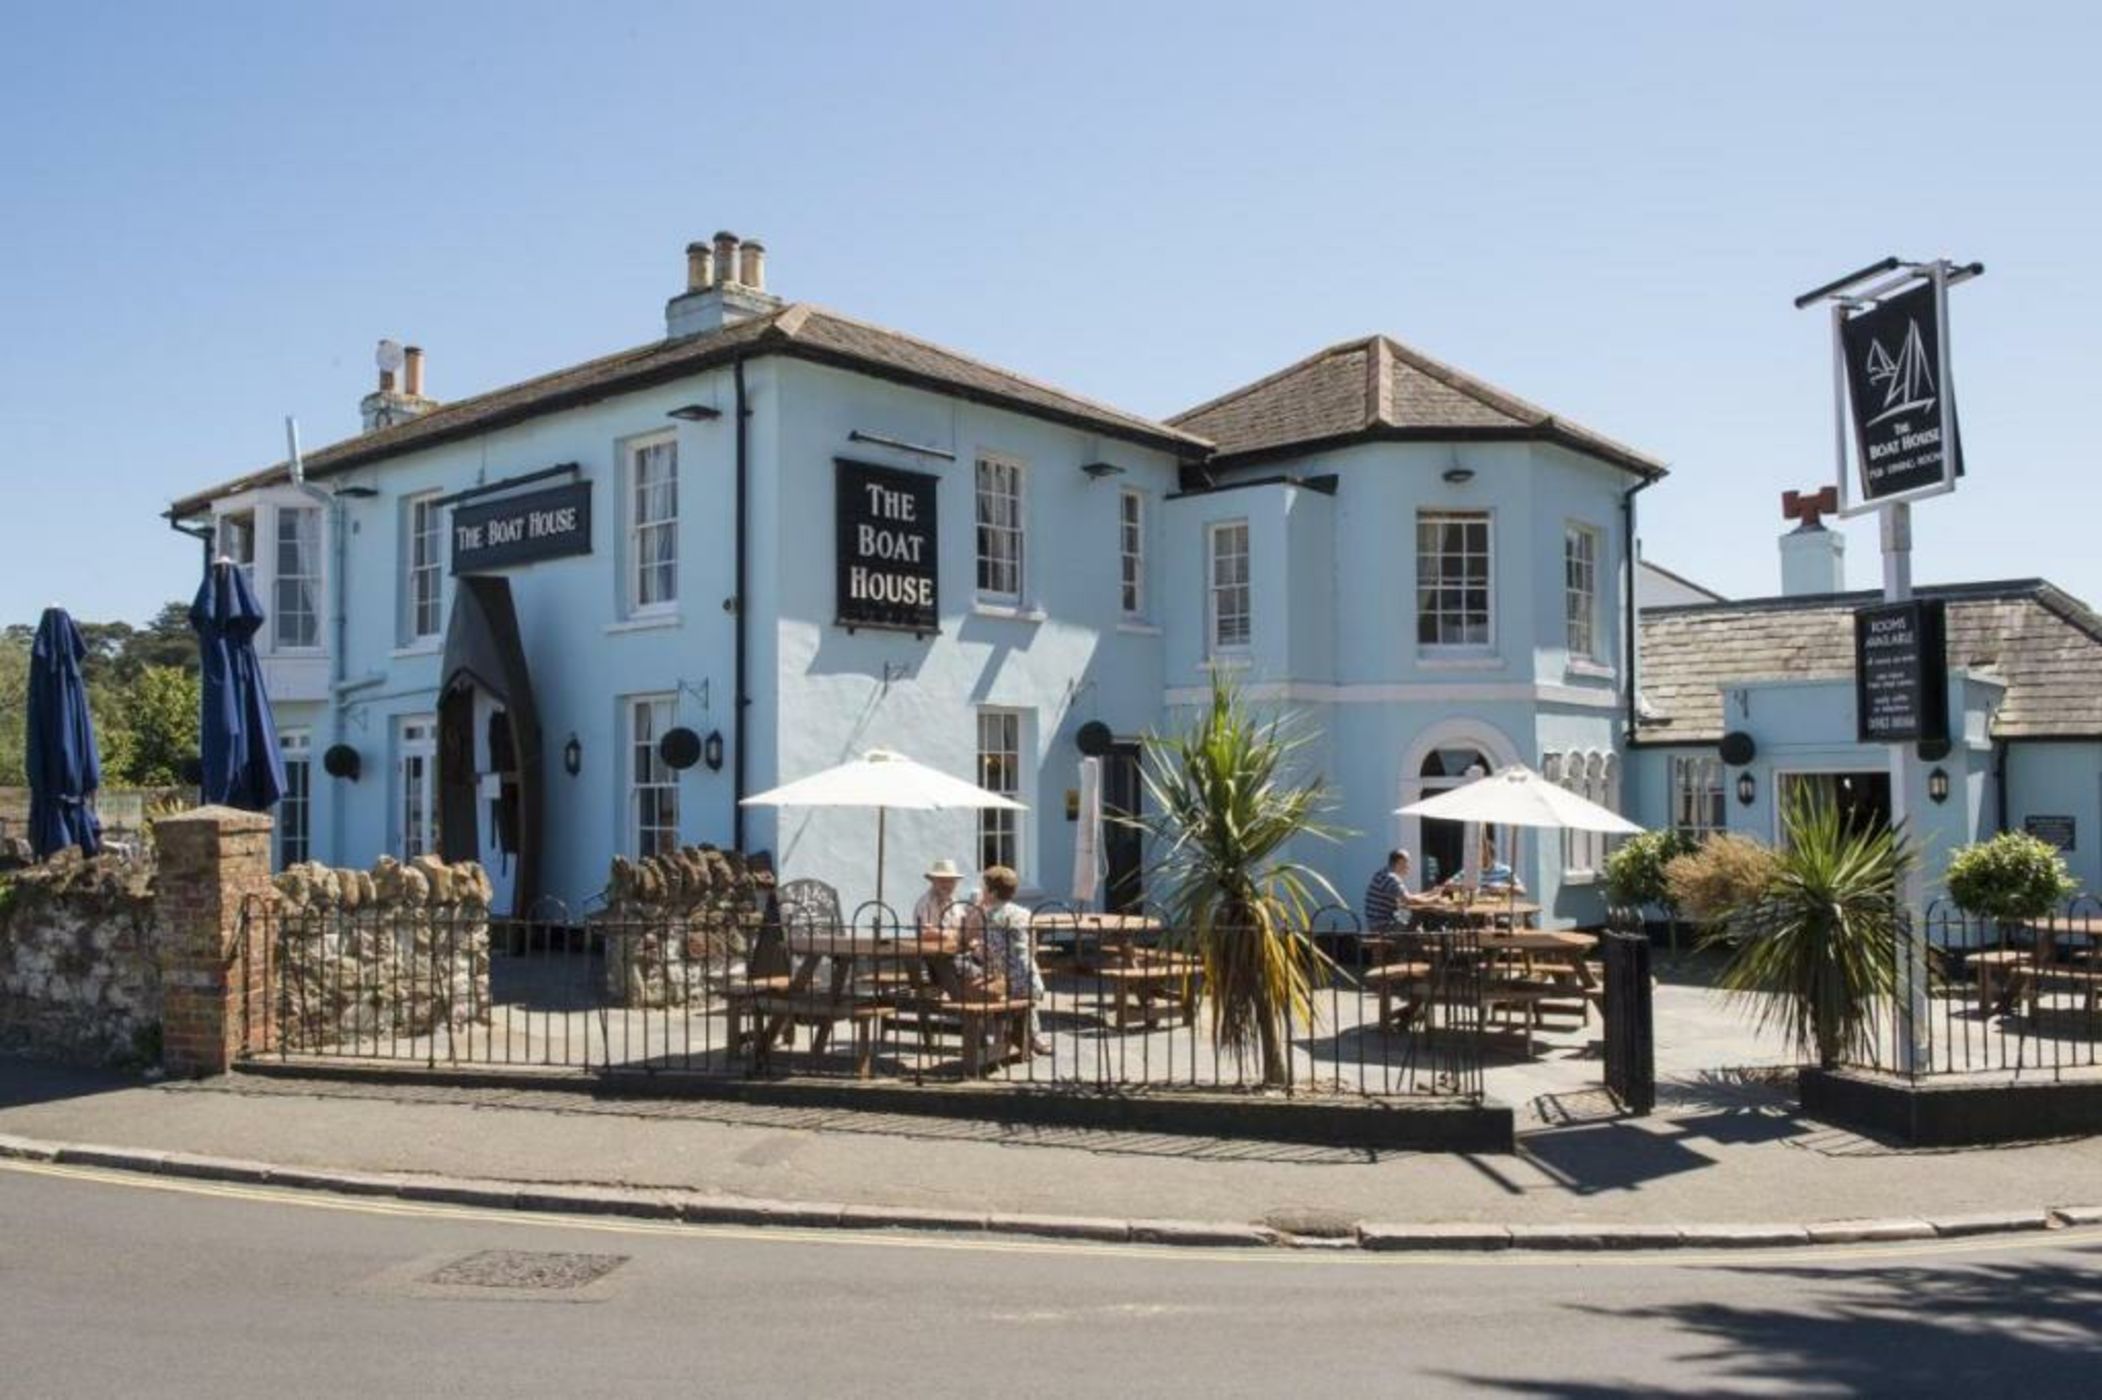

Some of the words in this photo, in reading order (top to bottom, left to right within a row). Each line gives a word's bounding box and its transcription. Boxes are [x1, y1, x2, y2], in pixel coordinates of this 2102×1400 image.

[1869, 440, 1899, 460] BOAT
[1902, 428, 1940, 450] HOUSE
[866, 483, 916, 521] THE
[457, 526, 484, 551] THE
[488, 517, 525, 546] BOAT
[529, 507, 577, 538] HOUSE
[858, 523, 924, 563] BOAT
[850, 565, 934, 606] HOUSE
